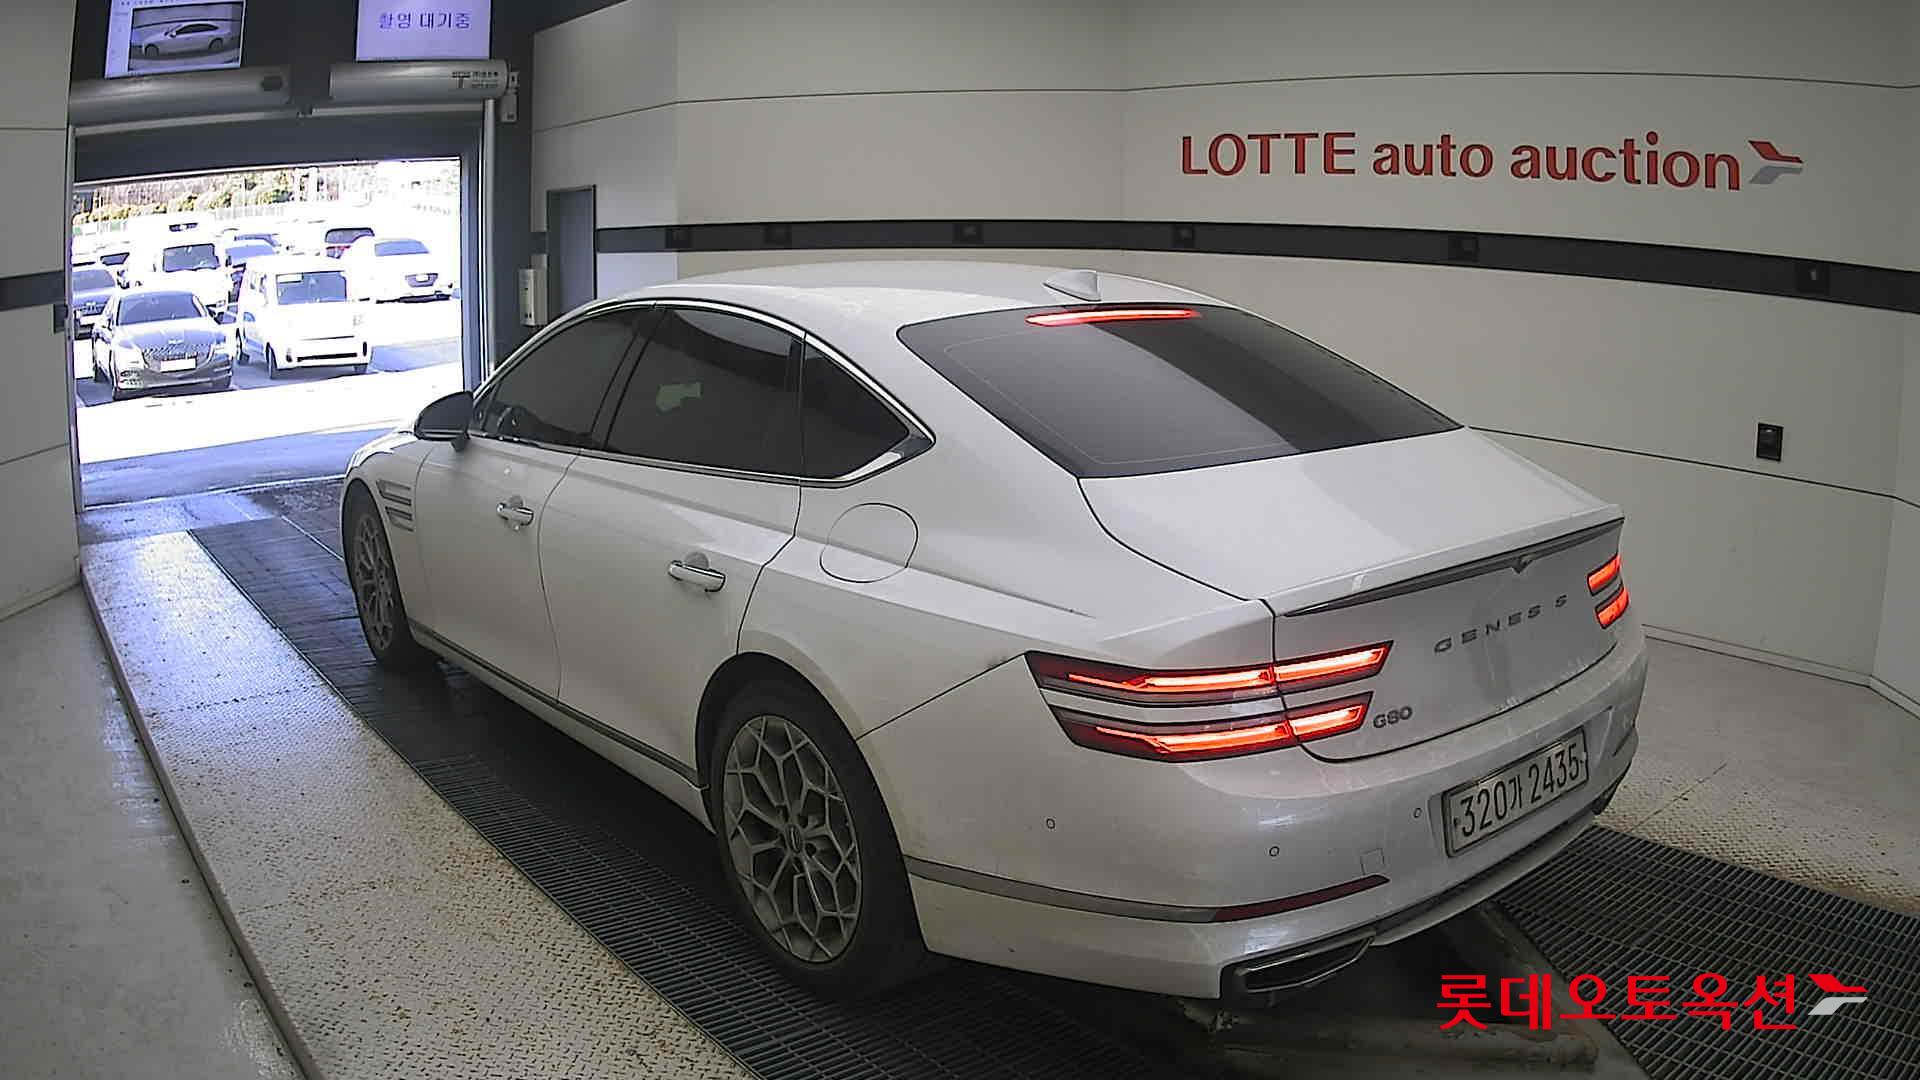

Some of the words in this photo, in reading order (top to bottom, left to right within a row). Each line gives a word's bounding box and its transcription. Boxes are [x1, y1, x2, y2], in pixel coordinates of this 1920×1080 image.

[419, 12, 470, 29] 대기중
[1181, 132, 1356, 176] LOTTE
[1372, 134, 1494, 178] auto
[1510, 131, 1741, 190] auction
[1433, 594, 1568, 653] GENESS
[1373, 706, 1413, 729] G80
[1528, 743, 1580, 804] 2435
